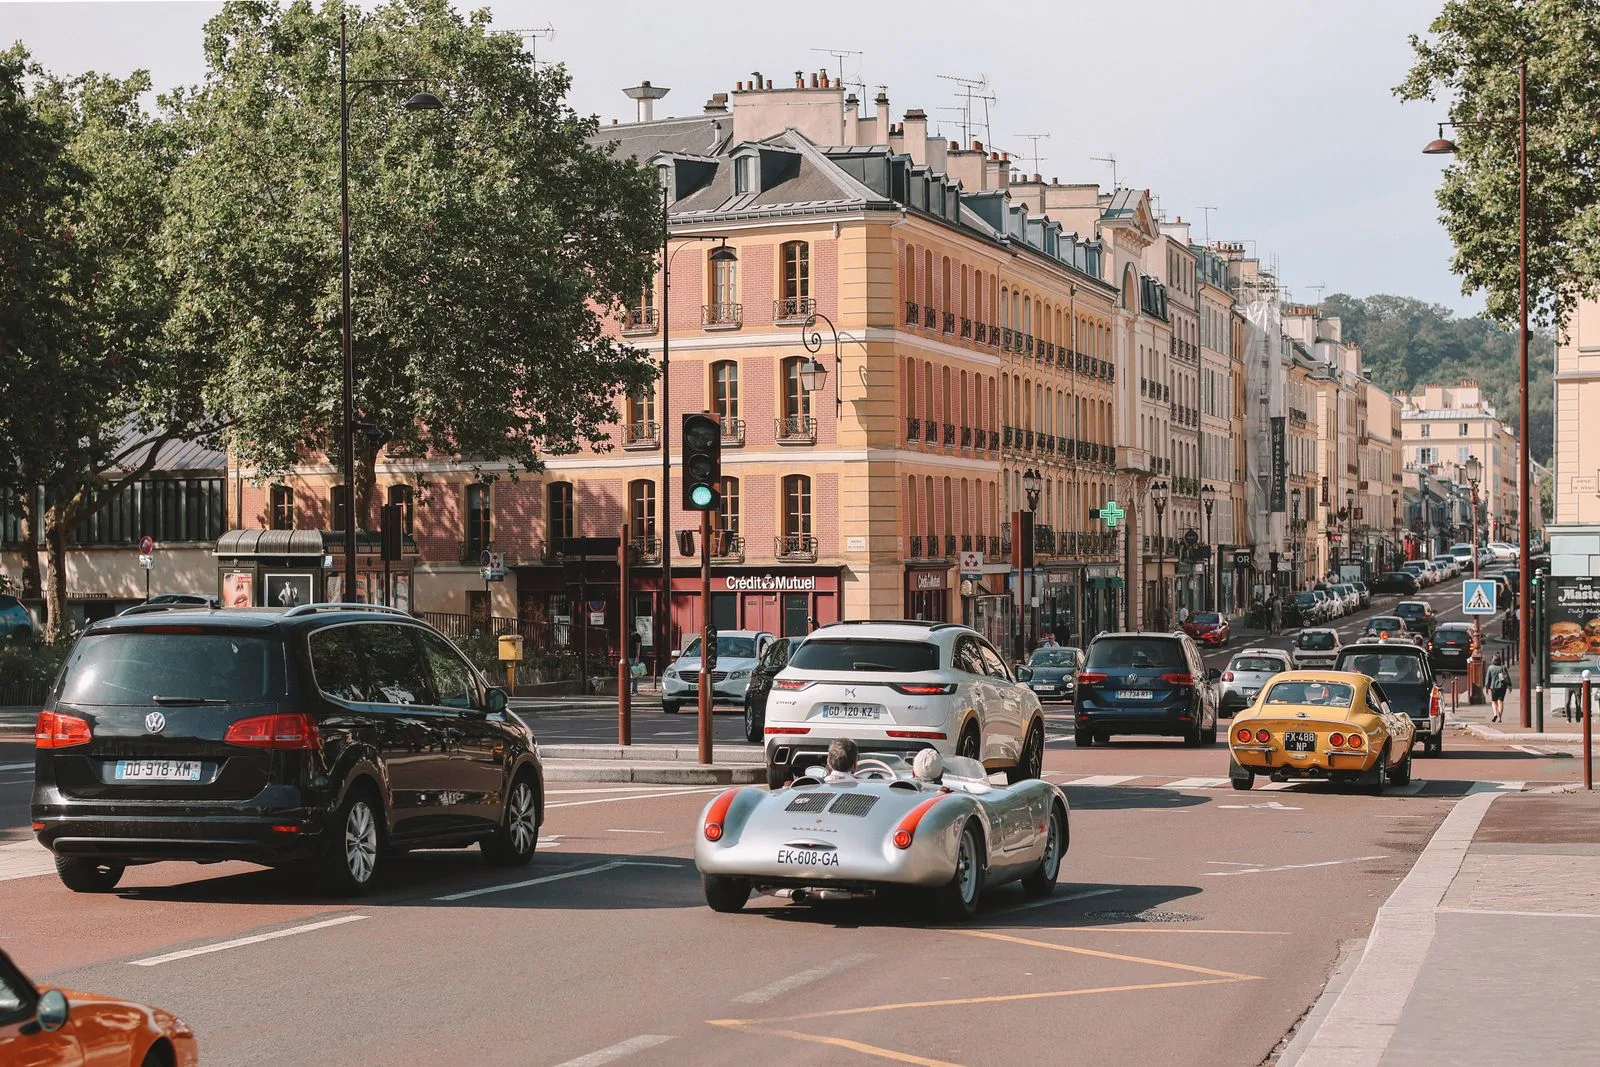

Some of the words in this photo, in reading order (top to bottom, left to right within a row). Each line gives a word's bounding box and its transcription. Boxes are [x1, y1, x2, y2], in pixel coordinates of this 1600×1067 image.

[726, 576, 762, 590] Crédit
[776, 576, 814, 590] Mutuel
[778, 850, 838, 866] EK-608-GA
